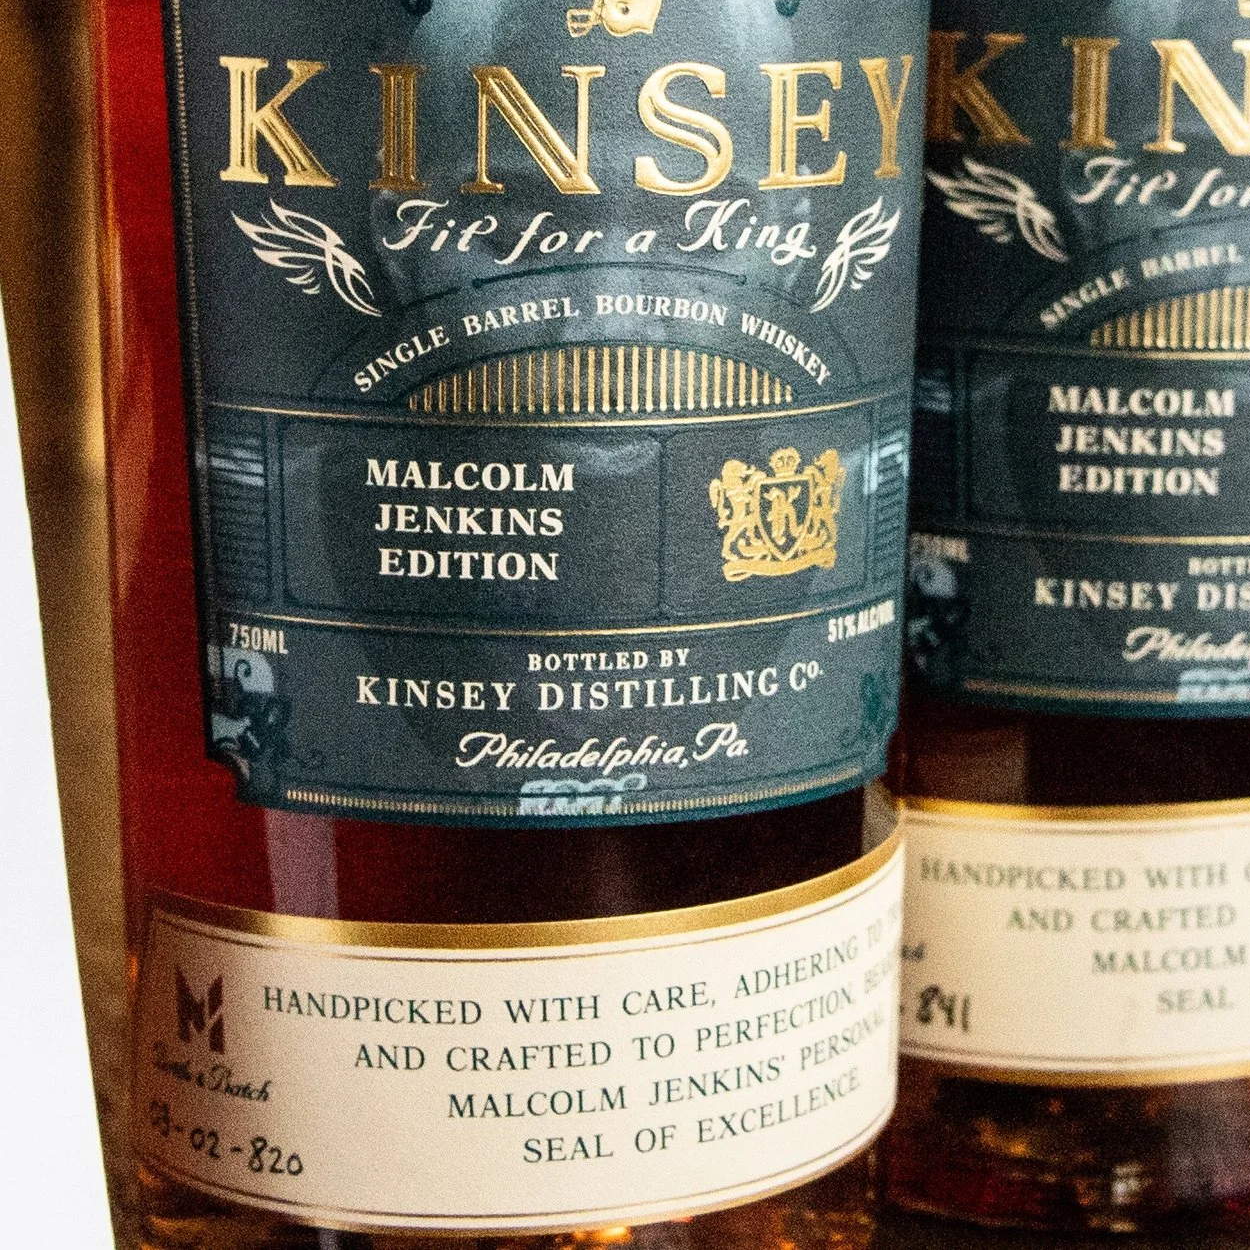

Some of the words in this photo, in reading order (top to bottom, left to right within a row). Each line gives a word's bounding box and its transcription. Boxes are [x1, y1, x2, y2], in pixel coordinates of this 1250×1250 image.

[219, 54, 914, 195] KINSEY
[1070, 155, 1176, 207] Fit
[382, 199, 497, 253] Fit
[494, 210, 602, 265] for
[625, 224, 658, 253] a
[676, 199, 818, 265] King
[354, 324, 452, 394] SINGLE
[462, 295, 581, 337] BARREL
[595, 294, 728, 328] BOURBON
[739, 311, 832, 388] WHISKEY
[1048, 384, 1236, 419] MALCOLM
[1055, 424, 1226, 458] JENKINS
[365, 458, 576, 493] MALCOLM
[1057, 464, 1220, 497] EDITION
[374, 503, 564, 537] JENKINS
[378, 549, 560, 583] EDITION
[1034, 576, 1181, 611] KINSEY
[229, 622, 289, 655] 750ML
[527, 651, 653, 672] BOTTLED
[659, 648, 690, 669] BY
[355, 676, 518, 711] KINSEY
[537, 668, 779, 711] DISTILLING
[455, 730, 689, 777] Philadelphia,
[920, 856, 1126, 892] HANDPICKED
[1144, 862, 1227, 890] WITH
[1007, 906, 1075, 933] AND
[1090, 904, 1237, 933] CRAFTED
[1092, 944, 1247, 974] MALCOLM
[263, 985, 483, 1025] HANDPICKED
[505, 993, 600, 1024] WITH
[621, 980, 717, 1018] CARE,
[733, 935, 859, 1001] ADHERING
[1156, 985, 1233, 1015] SEAL
[353, 1043, 426, 1071] AND
[446, 1042, 612, 1073] CRAFTED
[632, 1030, 676, 1061] TO
[447, 1086, 628, 1120] MALCOLM
[648, 1054, 786, 1111] JENKINS'
[523, 1133, 614, 1165] SEAL
[634, 1124, 677, 1156] OF
[696, 1066, 862, 1145] EXCELLENCE
